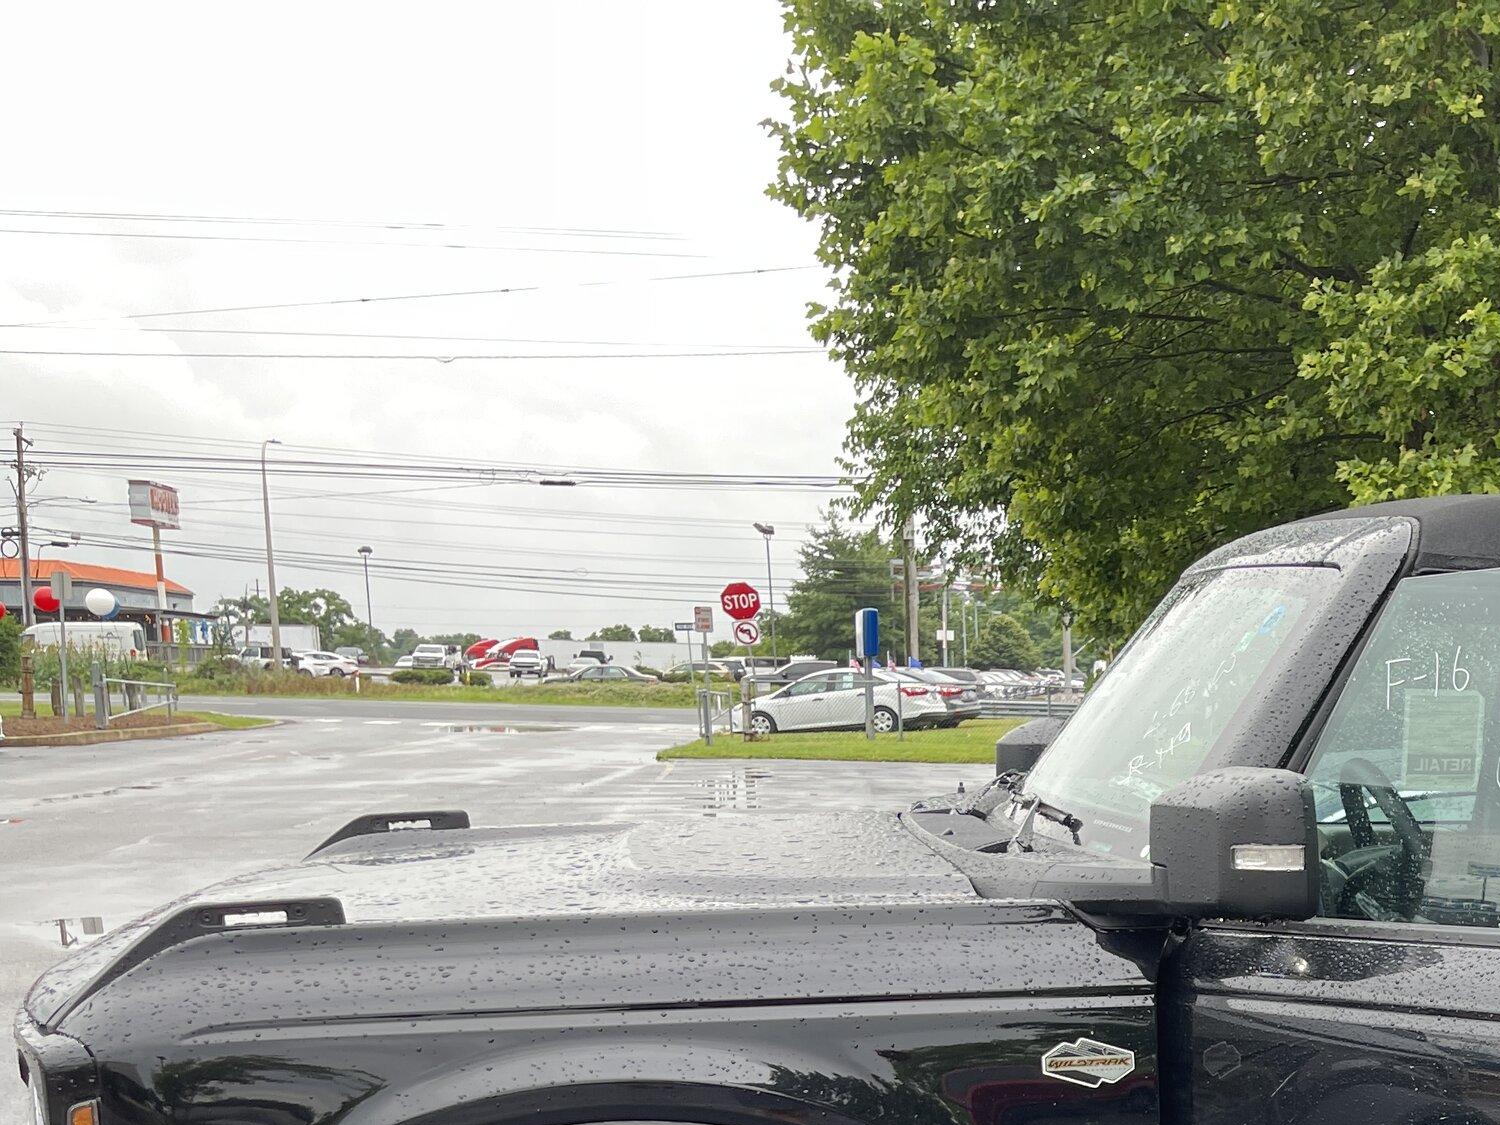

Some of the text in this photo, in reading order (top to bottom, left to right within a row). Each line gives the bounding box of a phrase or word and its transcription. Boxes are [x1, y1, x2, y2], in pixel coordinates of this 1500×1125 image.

[723, 593, 757, 611] STOP
[1385, 646, 1470, 710] F-16
[1048, 1057, 1131, 1069] WILDTRAK
